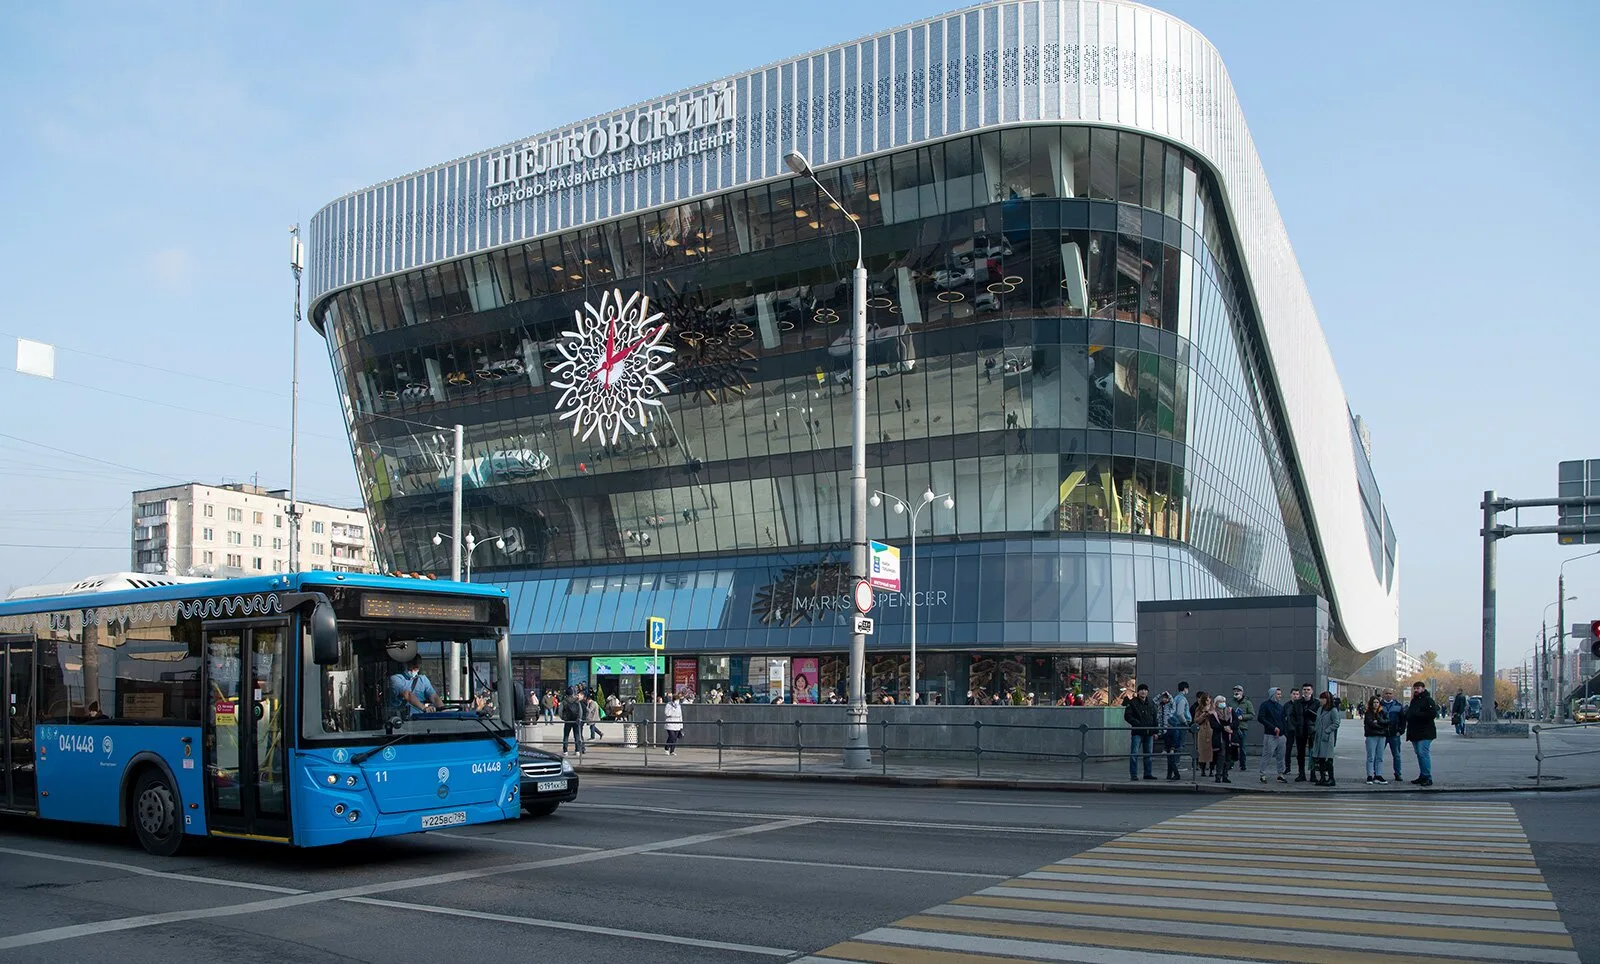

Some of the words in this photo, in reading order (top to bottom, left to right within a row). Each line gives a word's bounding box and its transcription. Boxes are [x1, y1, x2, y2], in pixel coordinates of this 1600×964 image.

[486, 81, 736, 189] ЩЁЛКОВСКИЙ
[486, 142, 683, 209] ТОРГОВО-РАЗВЛЕКАТЕЛЬНЫЙ
[688, 131, 736, 154] ЦЕНТР
[795, 594, 852, 611] MARKS
[872, 590, 948, 609] SPENCER
[59, 734, 94, 753] 041448
[375, 771, 388, 783] 11
[471, 761, 502, 774] 041448
